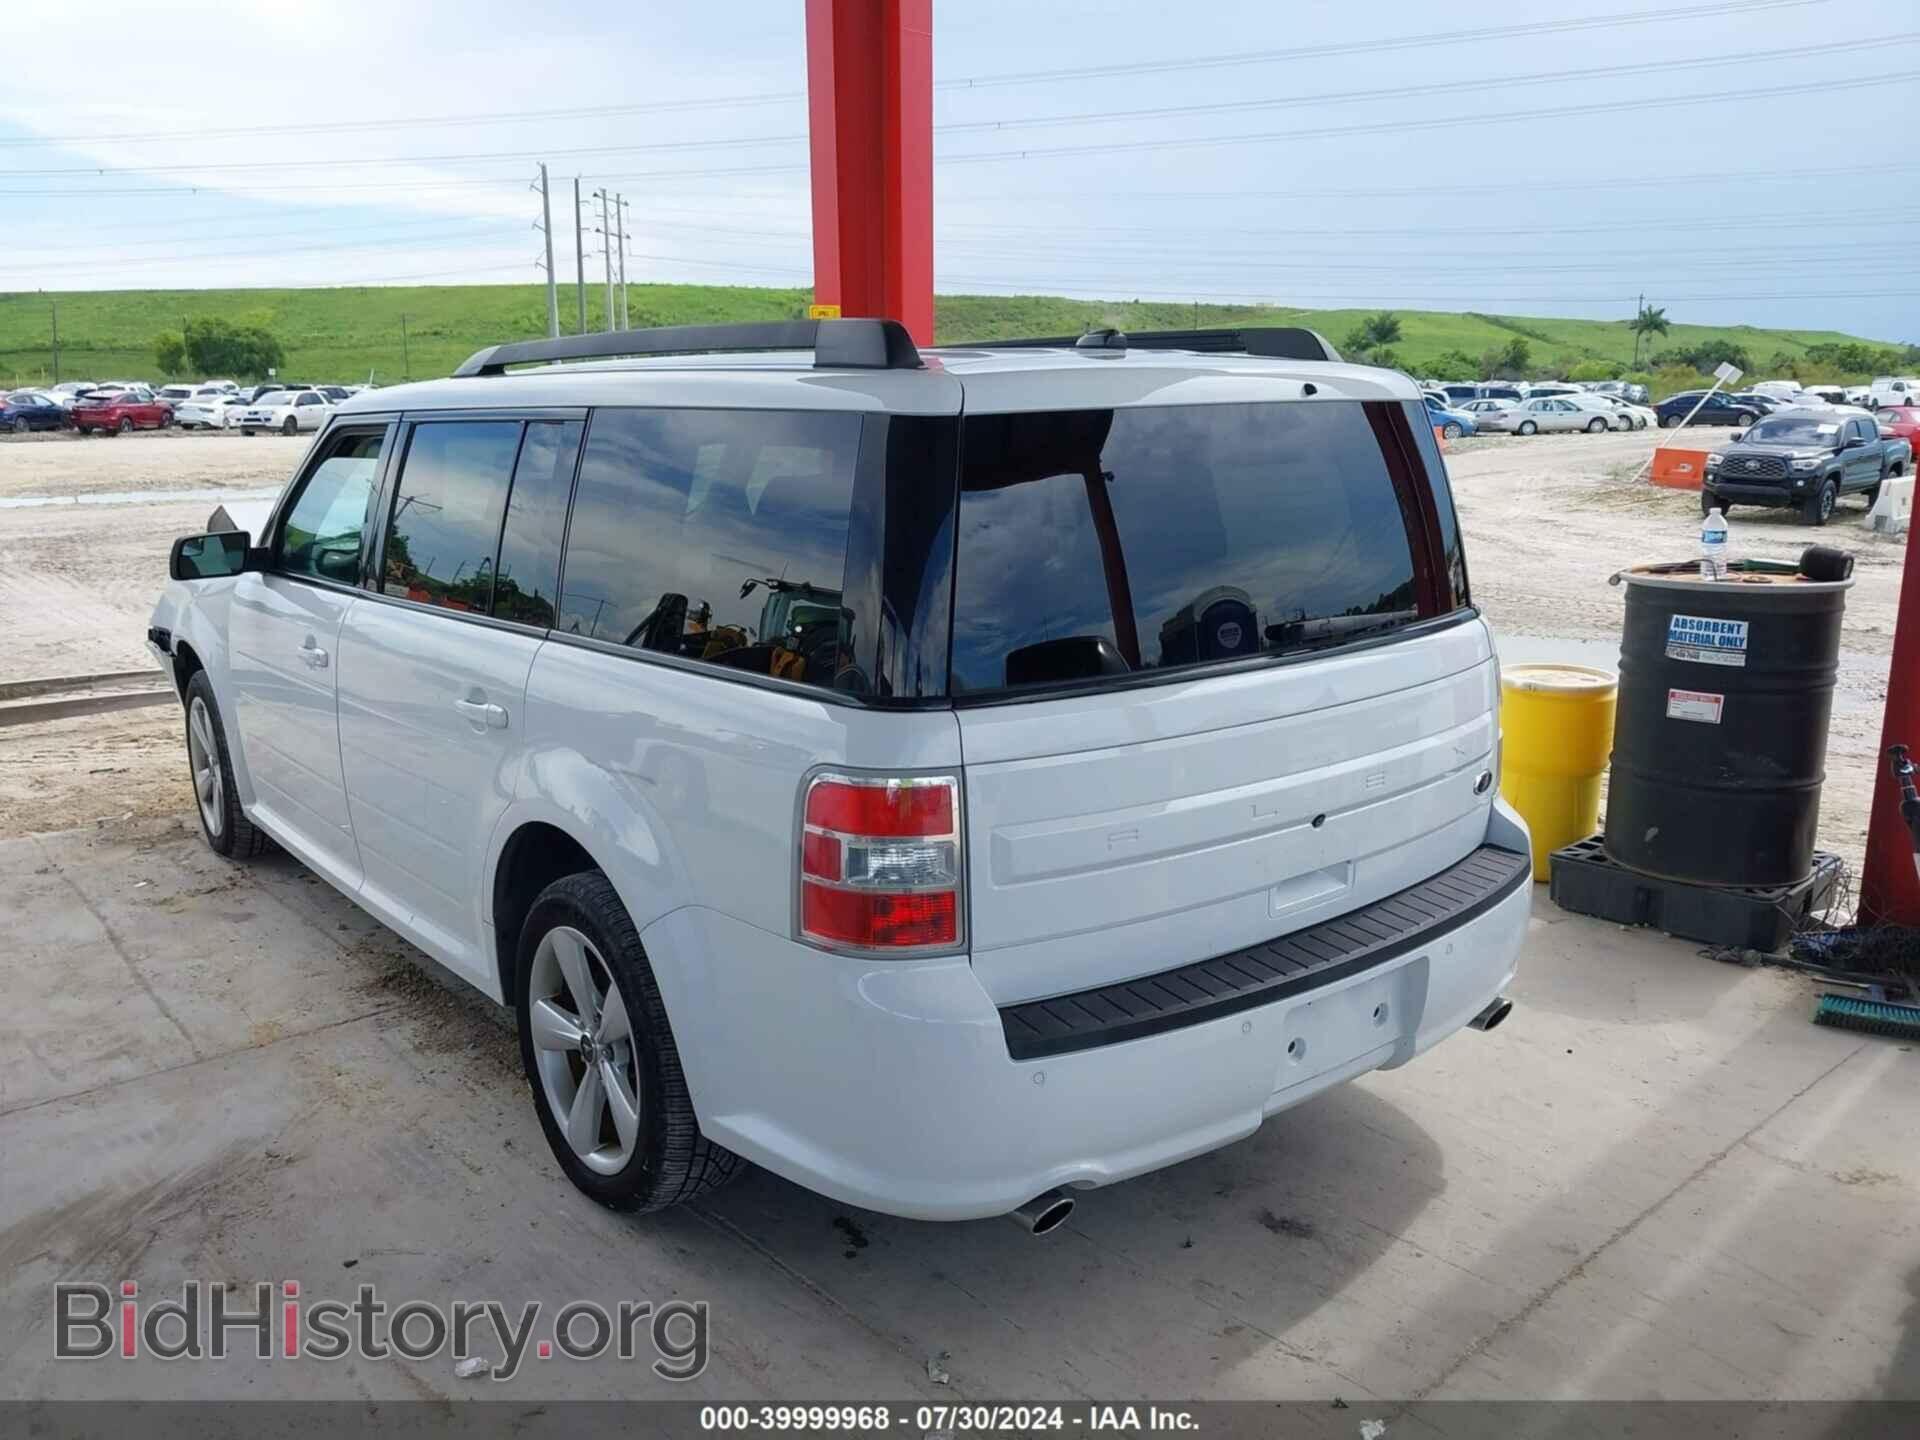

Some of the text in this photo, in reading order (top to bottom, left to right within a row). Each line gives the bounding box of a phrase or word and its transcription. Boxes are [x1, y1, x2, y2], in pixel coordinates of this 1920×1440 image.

[1673, 617, 1743, 635] ABSORBENT
[1668, 629, 1746, 648] MATERIAL ONLY
